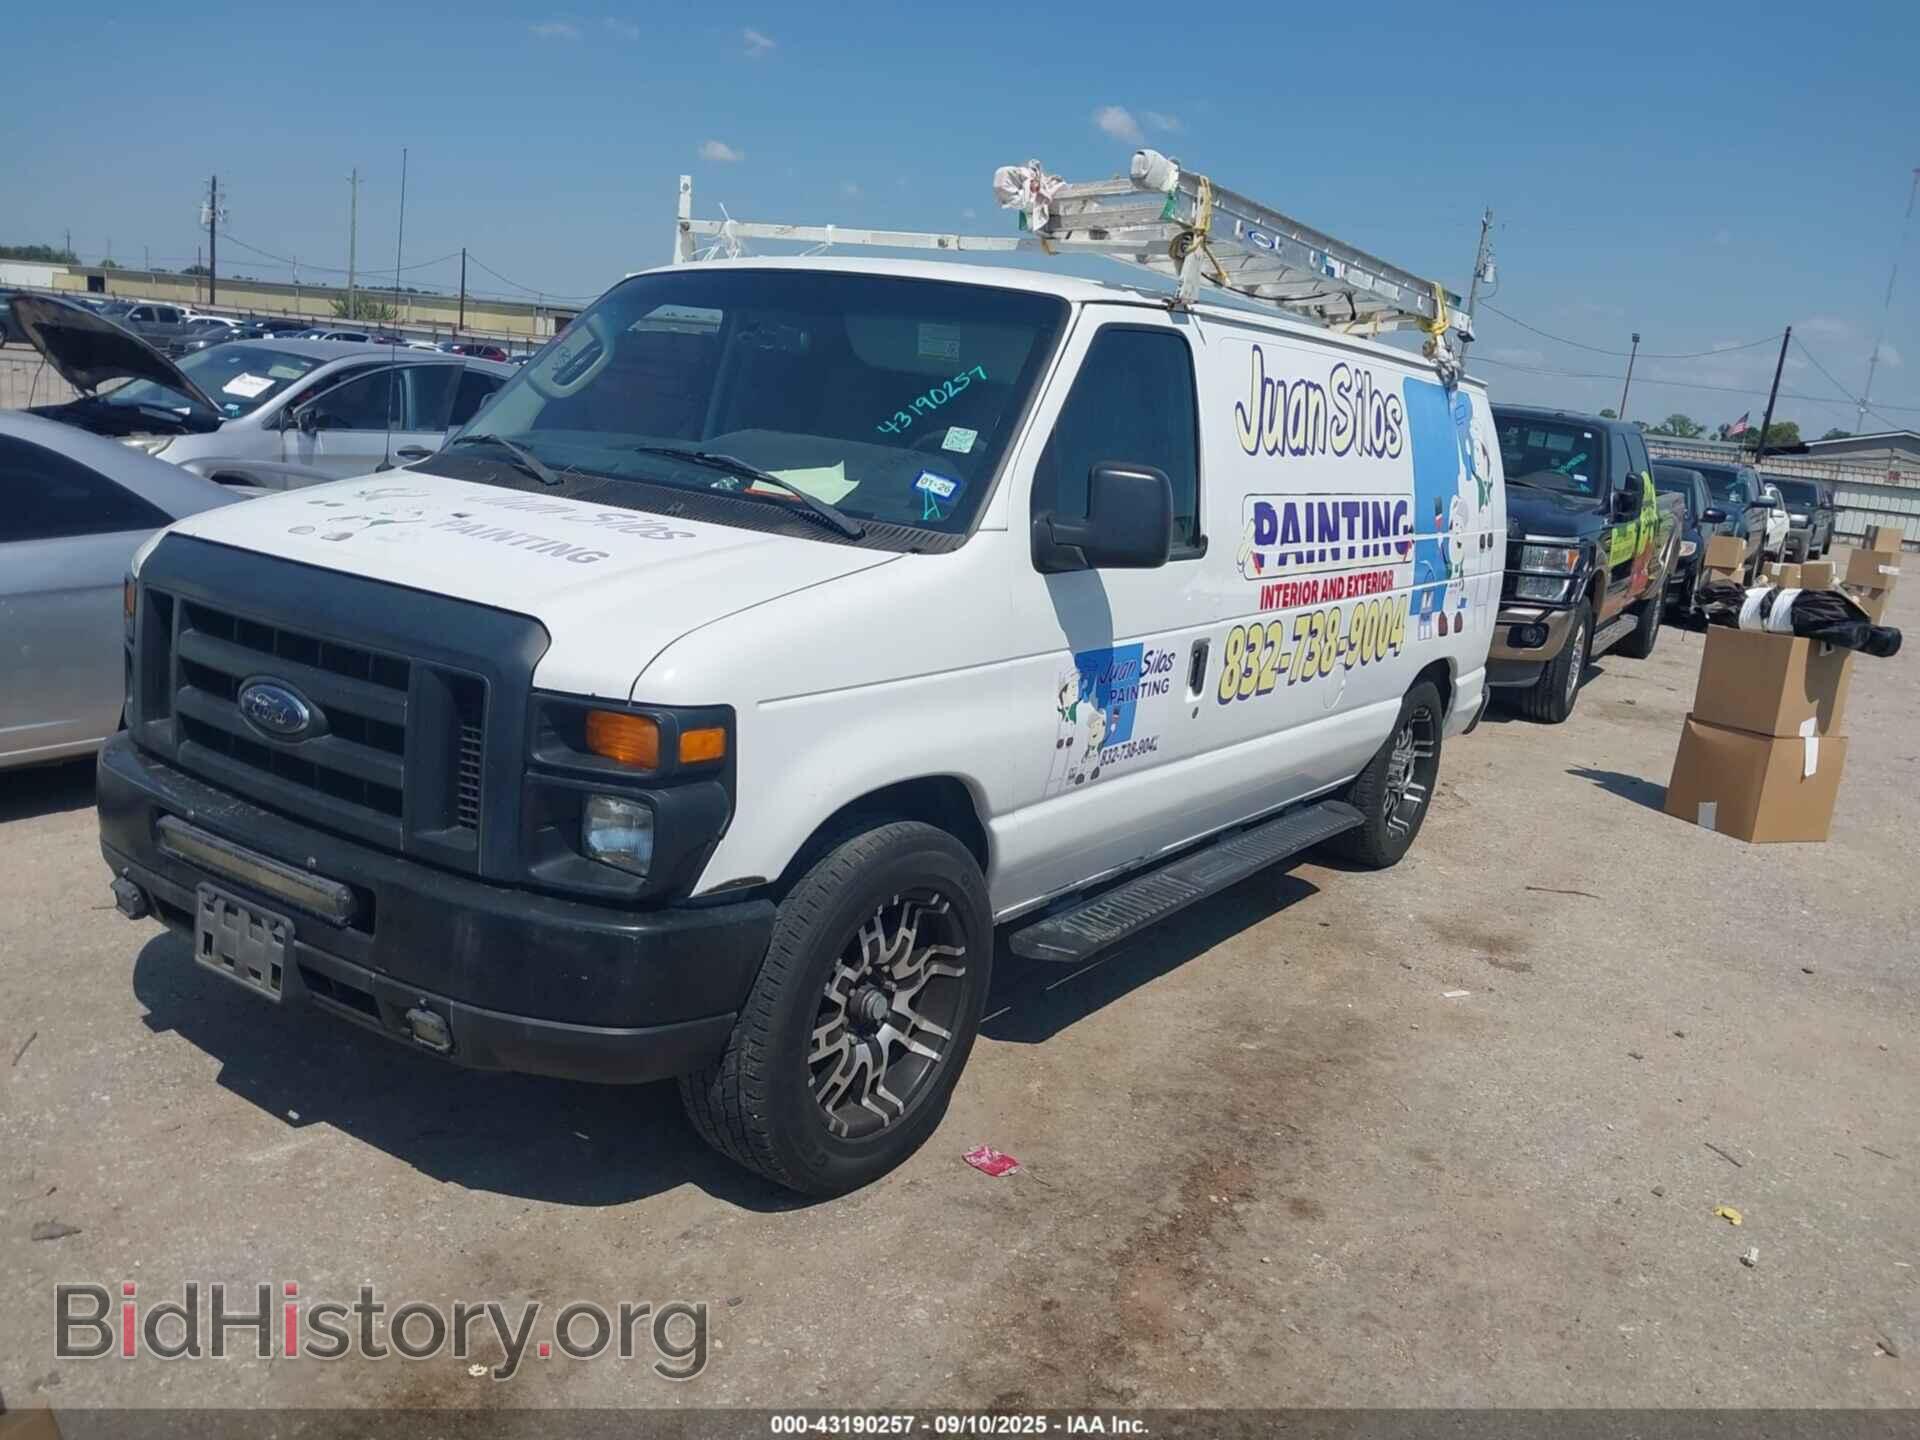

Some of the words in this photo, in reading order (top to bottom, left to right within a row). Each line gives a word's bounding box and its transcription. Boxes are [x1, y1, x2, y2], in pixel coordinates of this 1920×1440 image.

[878, 365, 989, 434] 43190257
[1235, 344, 1326, 456] Juan
[1329, 362, 1404, 460] Silos
[430, 517, 610, 565] PAINTING
[1253, 500, 1410, 567] PAINTING
[1260, 580, 1320, 610] INTERIOR
[1320, 577, 1345, 601] AND
[1346, 570, 1395, 597] EXTERIOR
[1099, 658, 1137, 684] Juan
[1139, 649, 1176, 678] Silos
[1217, 594, 1408, 706] 832-738-9004
[251, 692, 288, 725] Ford
[1110, 678, 1170, 705] PAINTING
